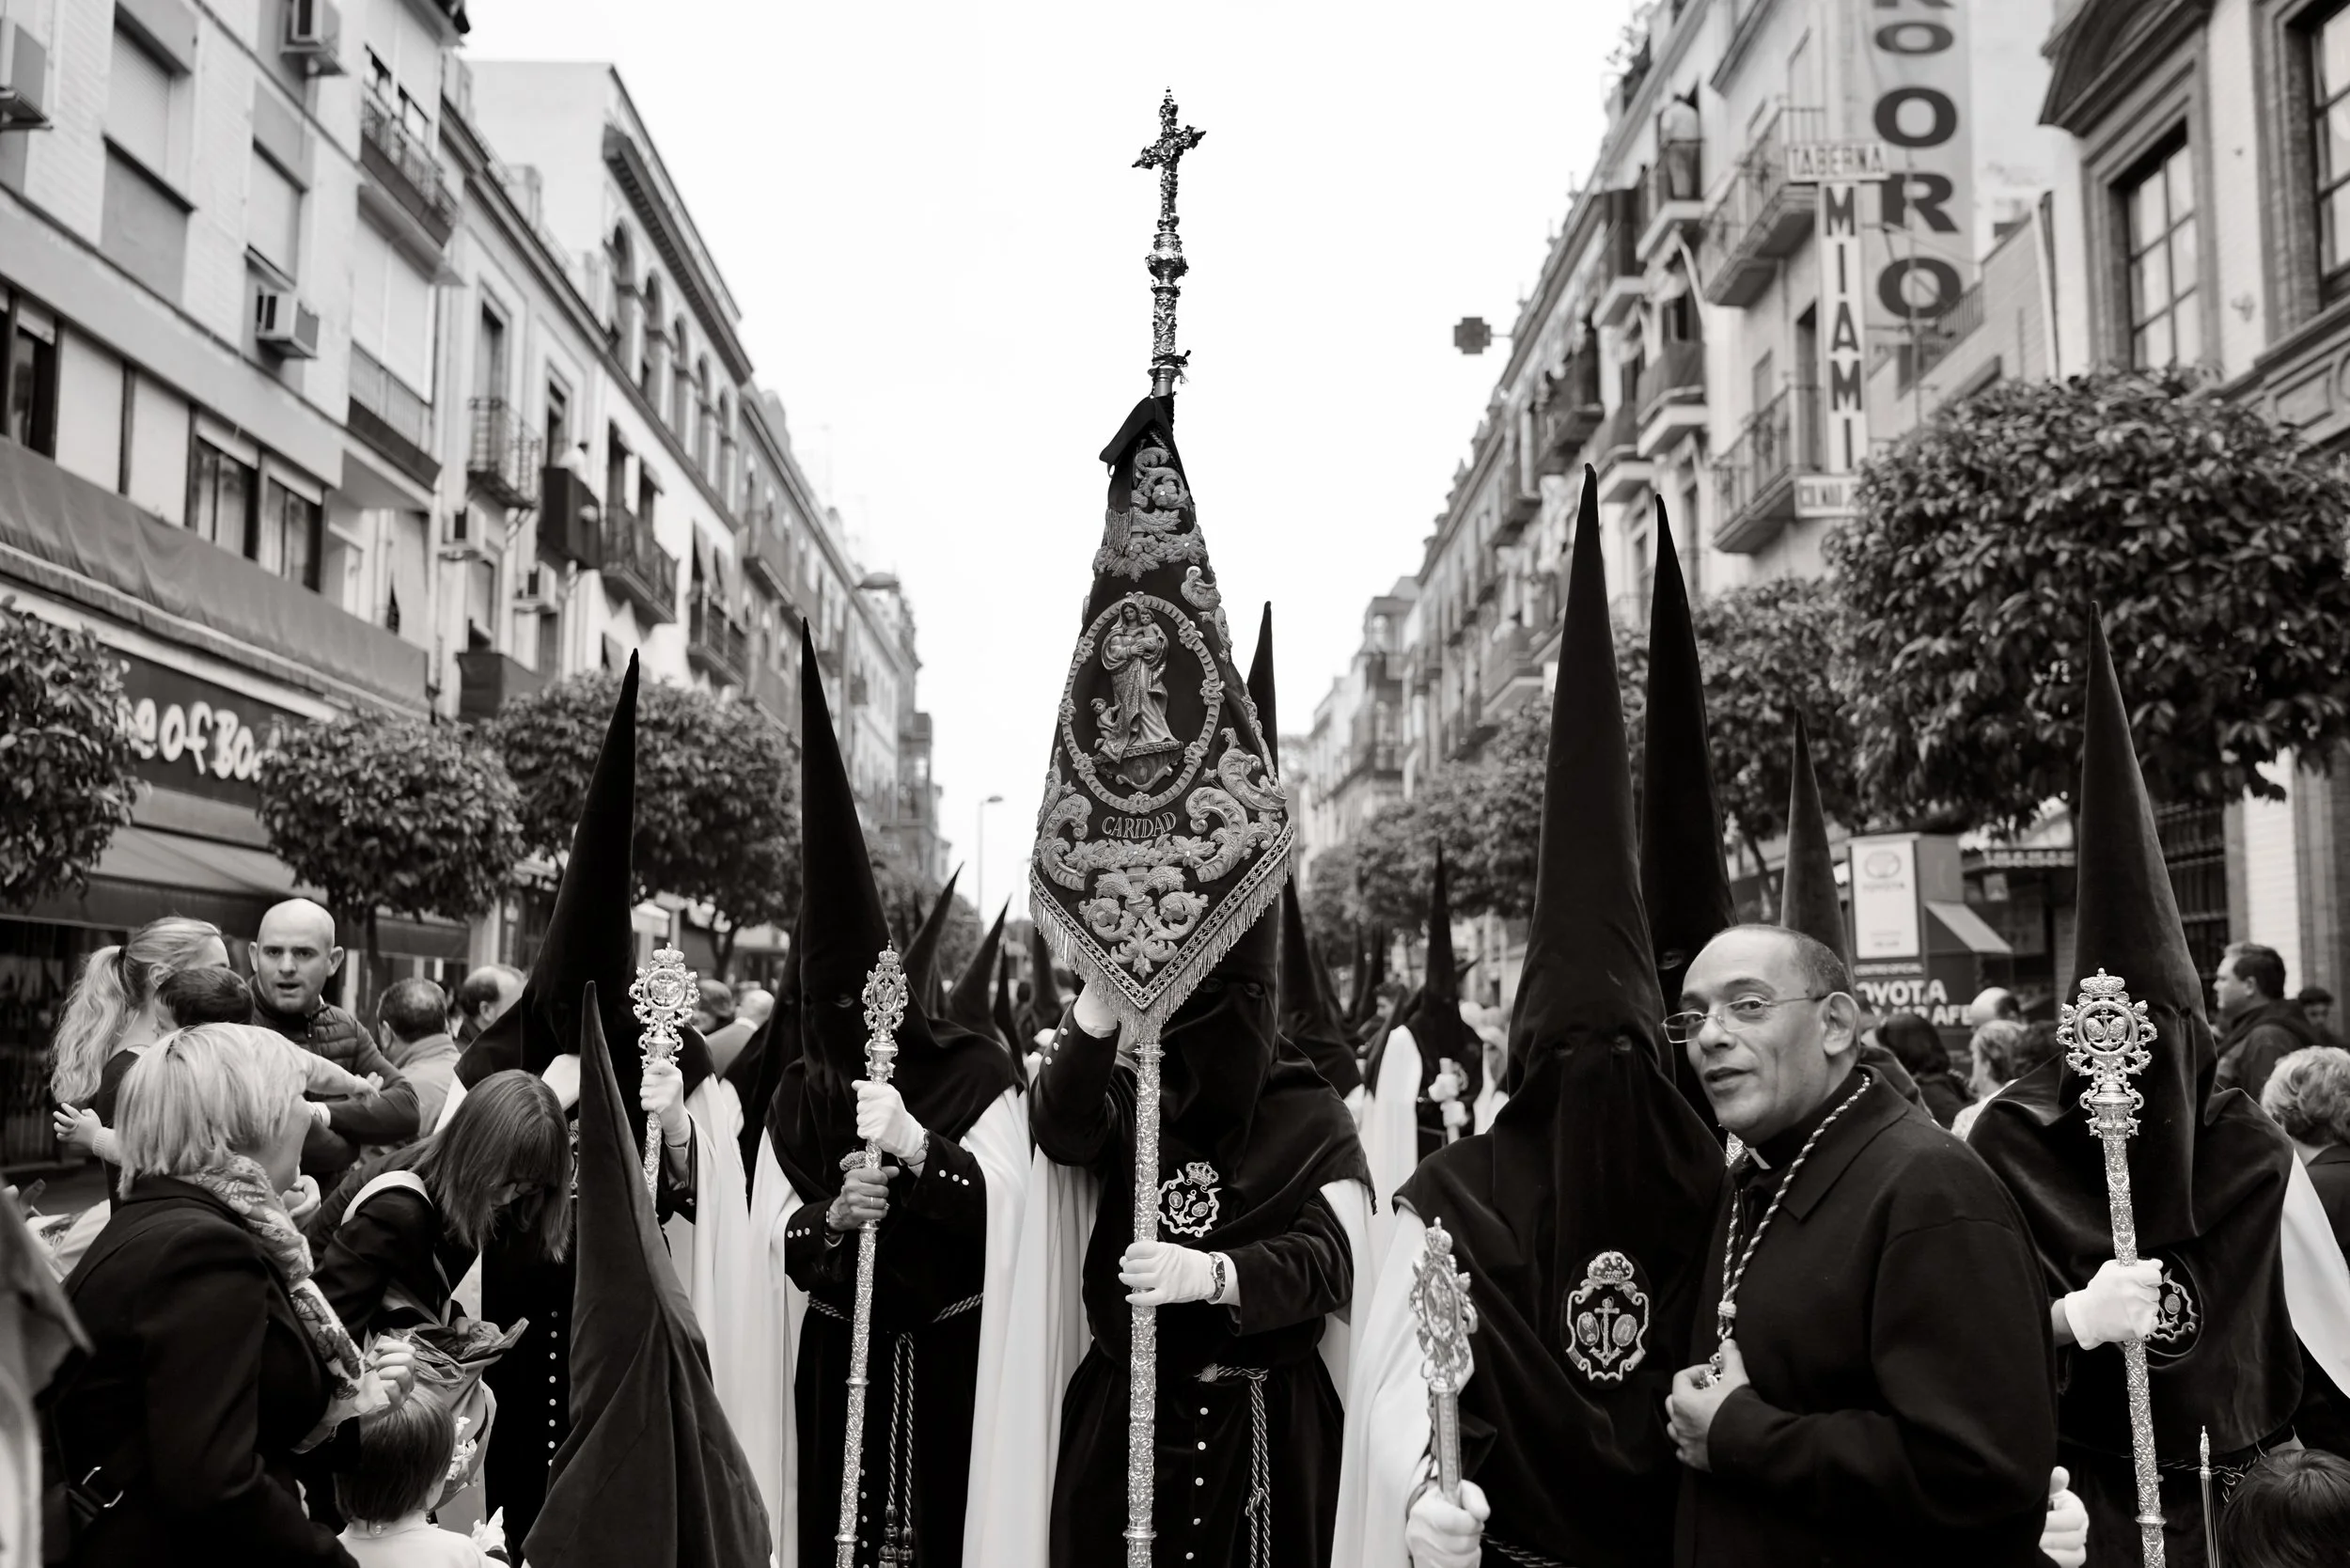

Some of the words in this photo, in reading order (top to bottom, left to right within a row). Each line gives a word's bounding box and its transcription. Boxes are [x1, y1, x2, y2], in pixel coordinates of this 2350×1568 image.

[1791, 147, 1885, 176] TABERNA
[1873, 86, 1962, 320] ORO
[1825, 186, 1863, 469] MIAMI
[1102, 811, 1177, 839] CARIDAD
[1856, 979, 1948, 1006] OYOTA
